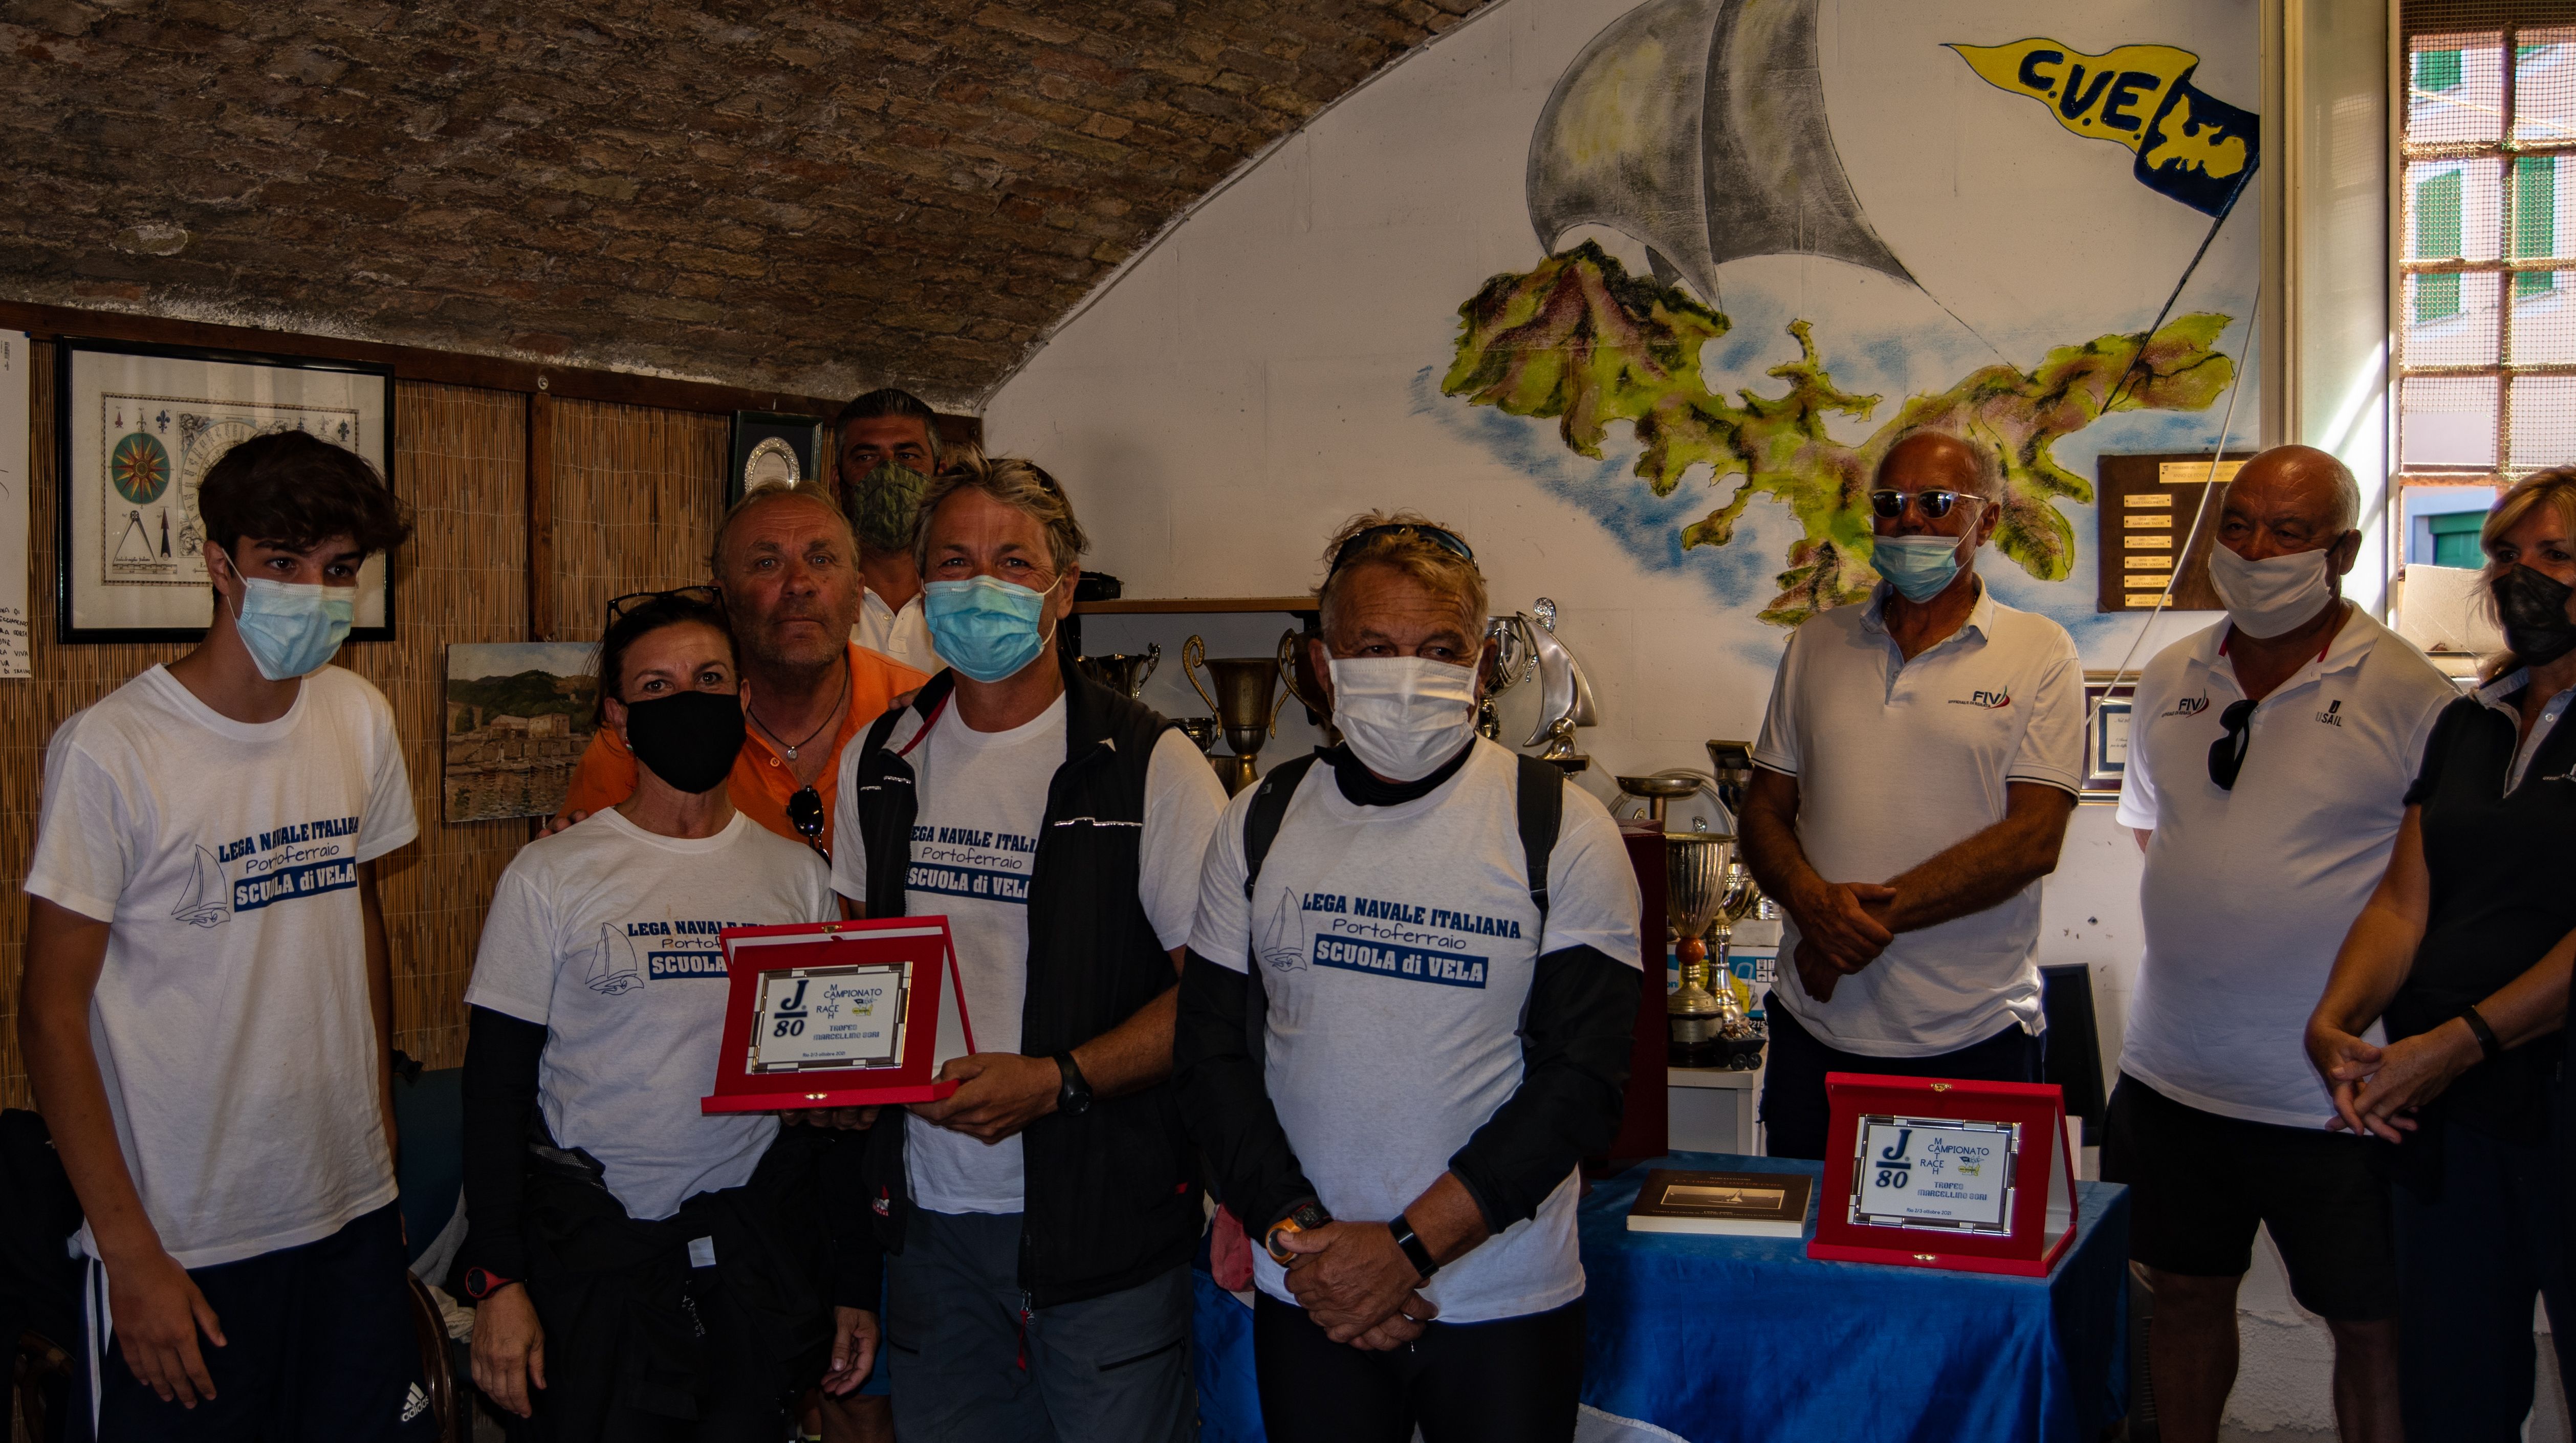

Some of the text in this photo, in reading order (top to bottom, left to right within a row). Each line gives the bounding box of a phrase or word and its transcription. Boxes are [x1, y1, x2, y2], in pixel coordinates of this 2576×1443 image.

[1973, 691, 2001, 705] FIV
[2178, 698, 2201, 711] FIV
[2316, 711, 2342, 727] USAIL
[219, 837, 256, 863] LEGA
[260, 822, 310, 850] NAVALE
[910, 825, 1037, 854] EGA NAVALE ITALI
[246, 843, 340, 874] Portoferraio
[921, 846, 1022, 869] Portoferraio
[236, 863, 356, 906] SCUOLA di VELA
[907, 867, 969, 891] SCUOLA
[973, 874, 988, 893] di
[1302, 892, 1521, 939] LEGA NAVALE ITALIANA
[627, 922, 671, 936] LEGA
[1332, 918, 1467, 950] Portoferraio
[662, 935, 722, 949] Portof
[651, 956, 728, 974] SCUOLA
[1316, 940, 1485, 982] SCUOLA di VELA
[780, 979, 810, 1011] J
[823, 988, 883, 999] CAMPIONATO
[773, 1019, 805, 1038] 80
[1883, 1129, 1913, 1161] J
[1927, 1144, 1990, 1156] CAMPIONATO
[1875, 1170, 1909, 1189] 80
[1934, 1181, 1964, 1190] TROFEO
[1917, 1189, 1968, 1199] MARCELLINO
[401, 1395, 429, 1422] adidas
